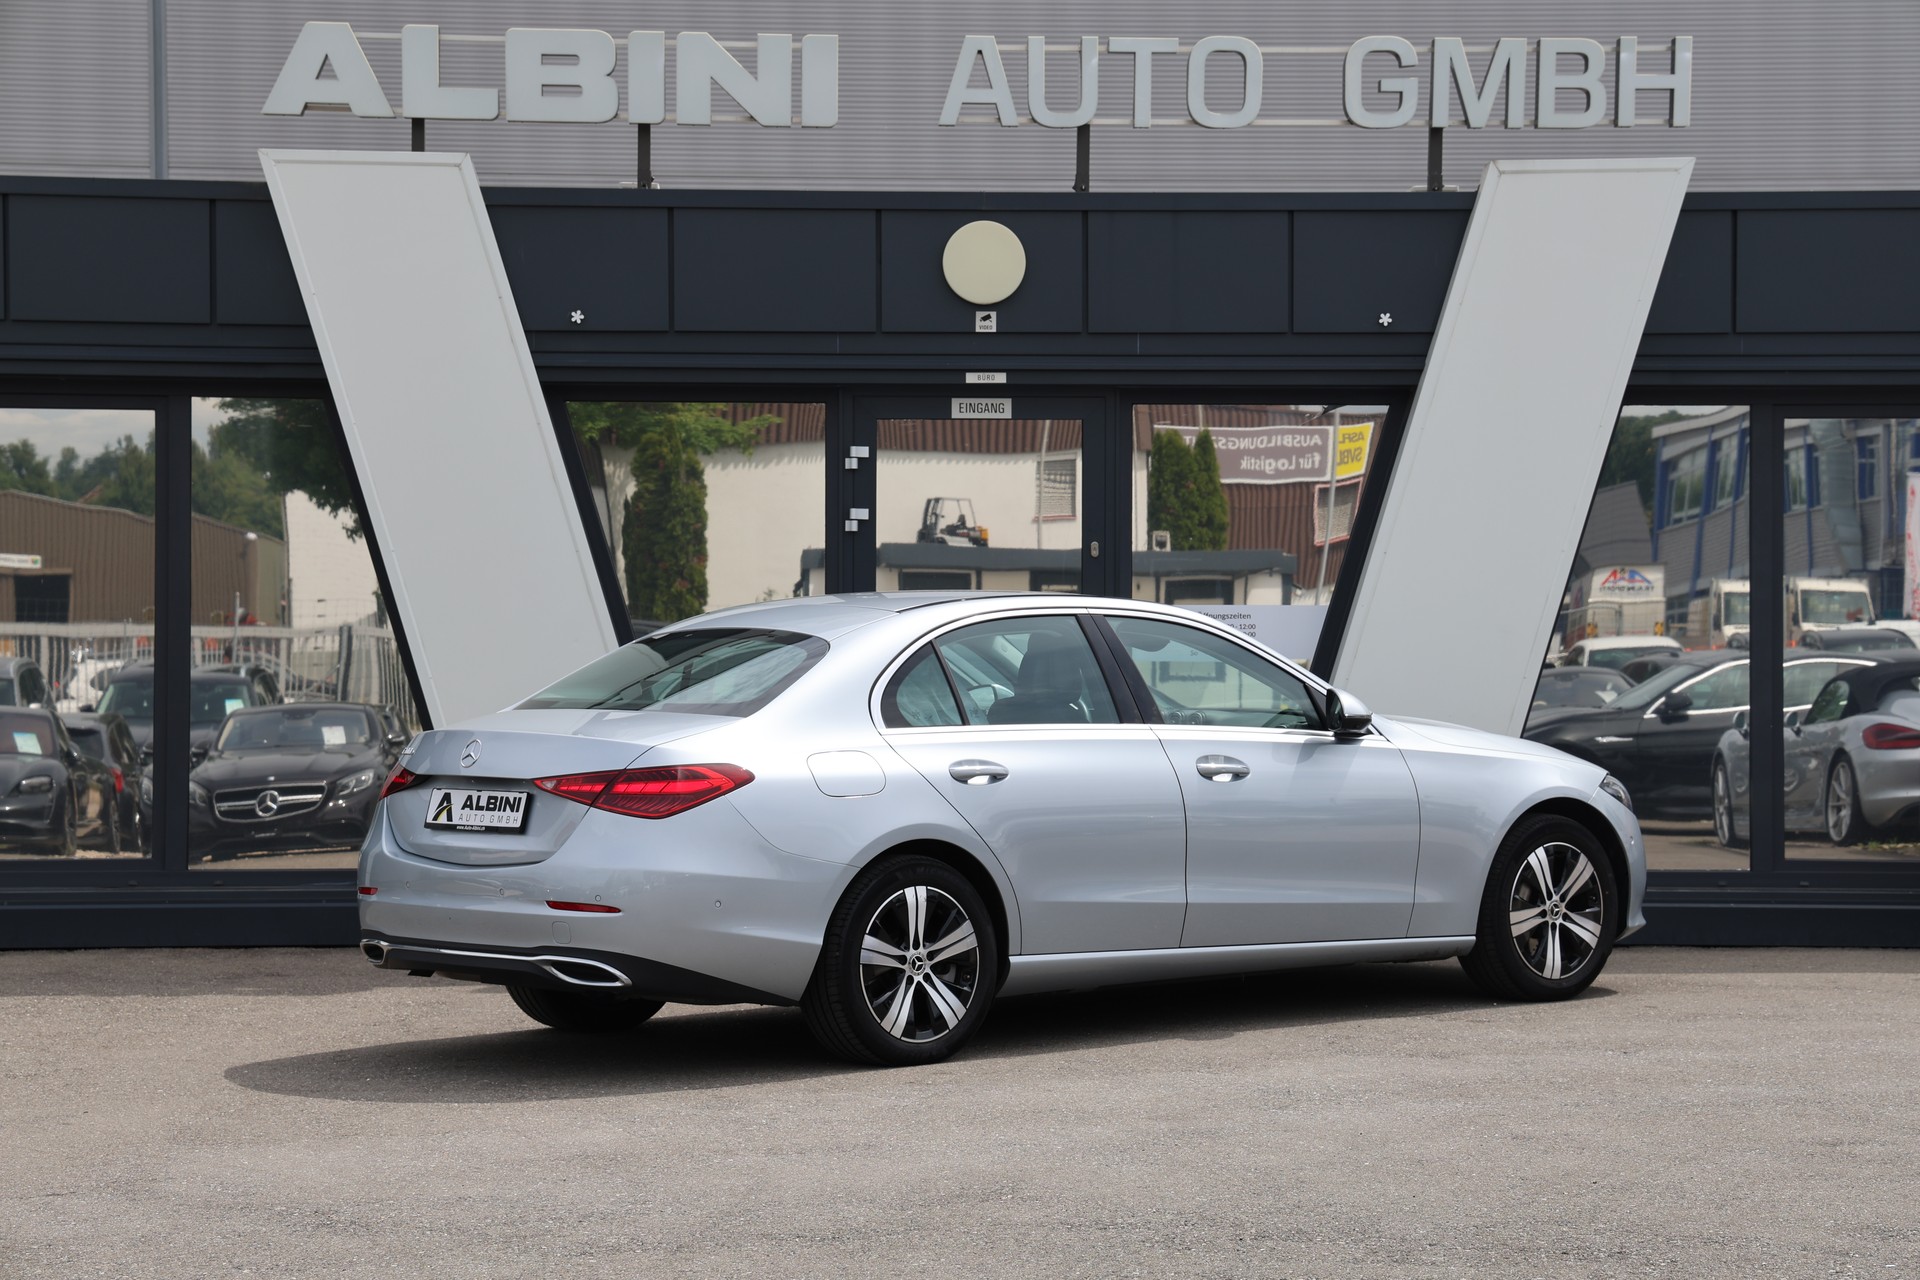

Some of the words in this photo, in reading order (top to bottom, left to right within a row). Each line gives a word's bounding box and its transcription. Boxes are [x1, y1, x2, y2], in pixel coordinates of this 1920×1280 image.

[261, 21, 840, 129] ALBINI
[938, 35, 1264, 130] AUTO
[1343, 35, 1693, 130] GMBH
[977, 373, 996, 381] BÜRO
[959, 402, 1005, 414] EINGANG
[461, 794, 523, 813] ALBINI
[458, 813, 485, 823] AUTO
[489, 814, 519, 825] GMBH
